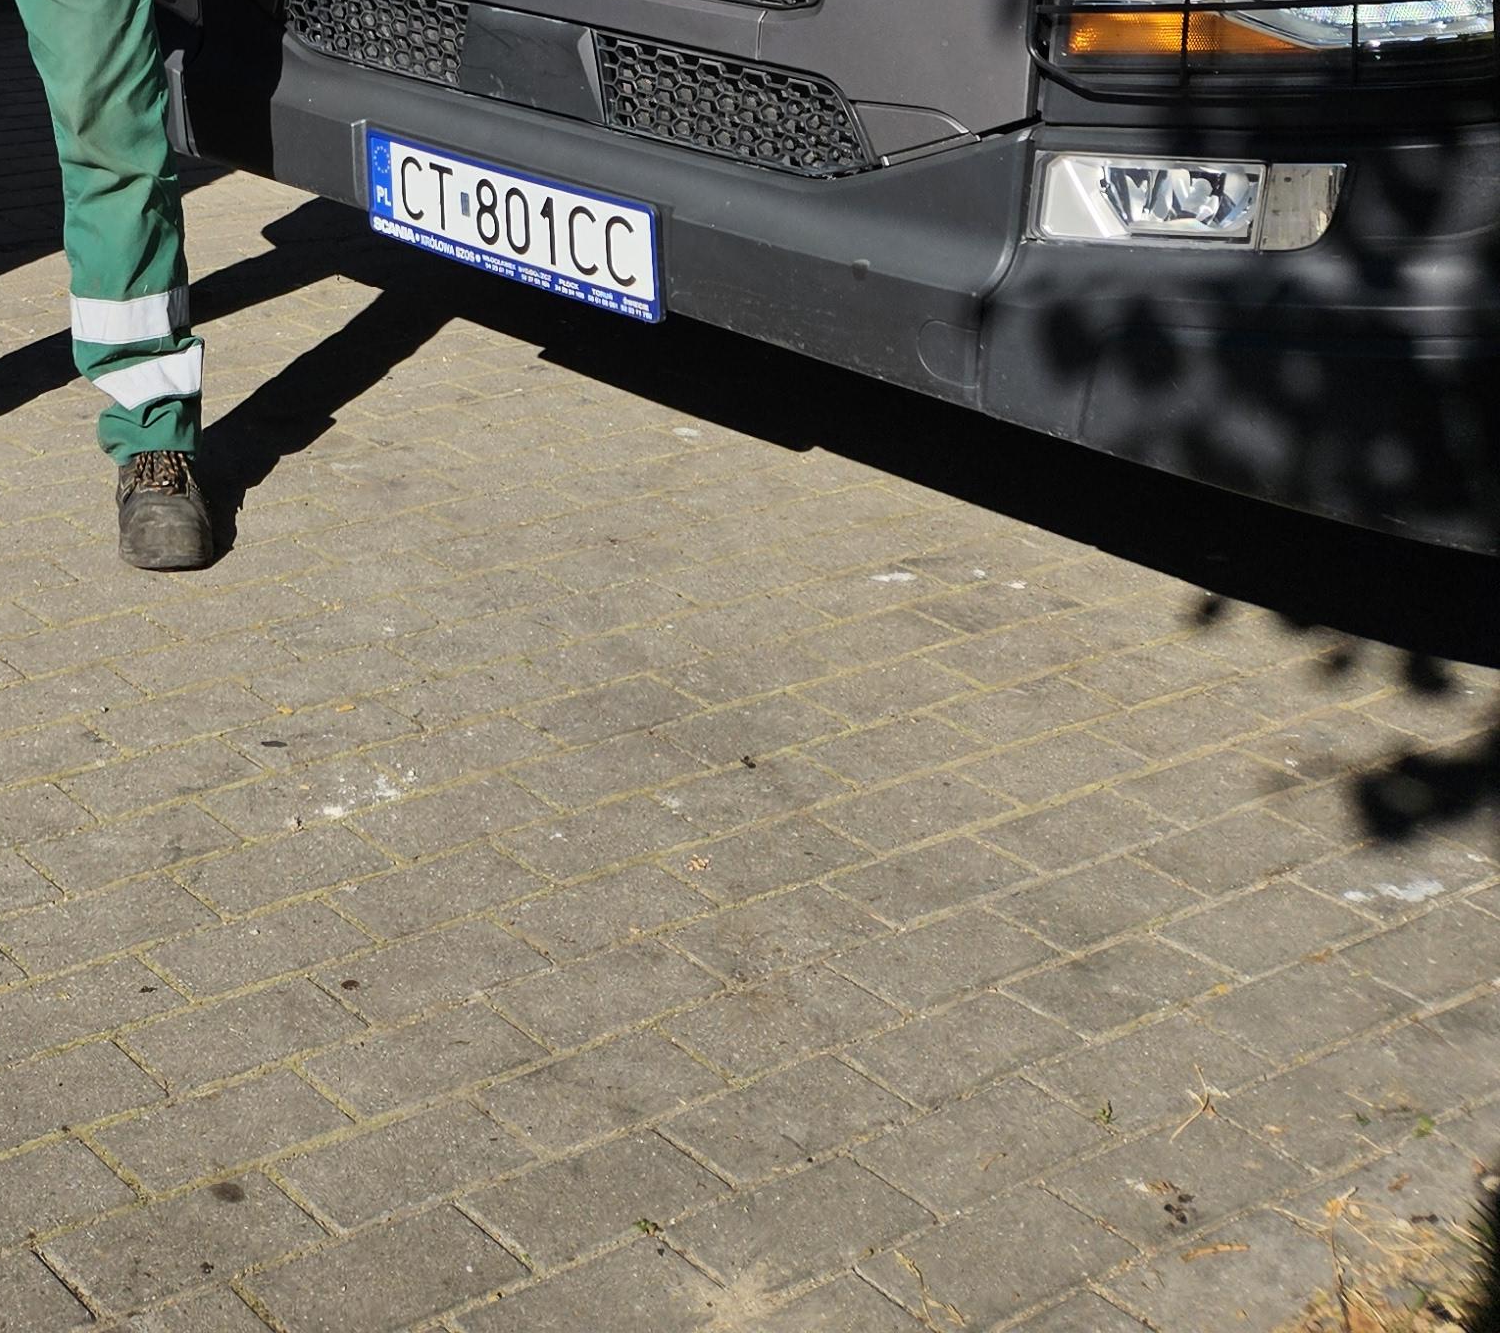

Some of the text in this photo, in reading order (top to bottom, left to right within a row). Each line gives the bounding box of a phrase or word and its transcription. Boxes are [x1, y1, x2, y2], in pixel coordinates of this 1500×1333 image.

[376, 185, 392, 208] PL
[373, 216, 416, 244] SCANIA
[400, 156, 637, 287] CT 801CC
